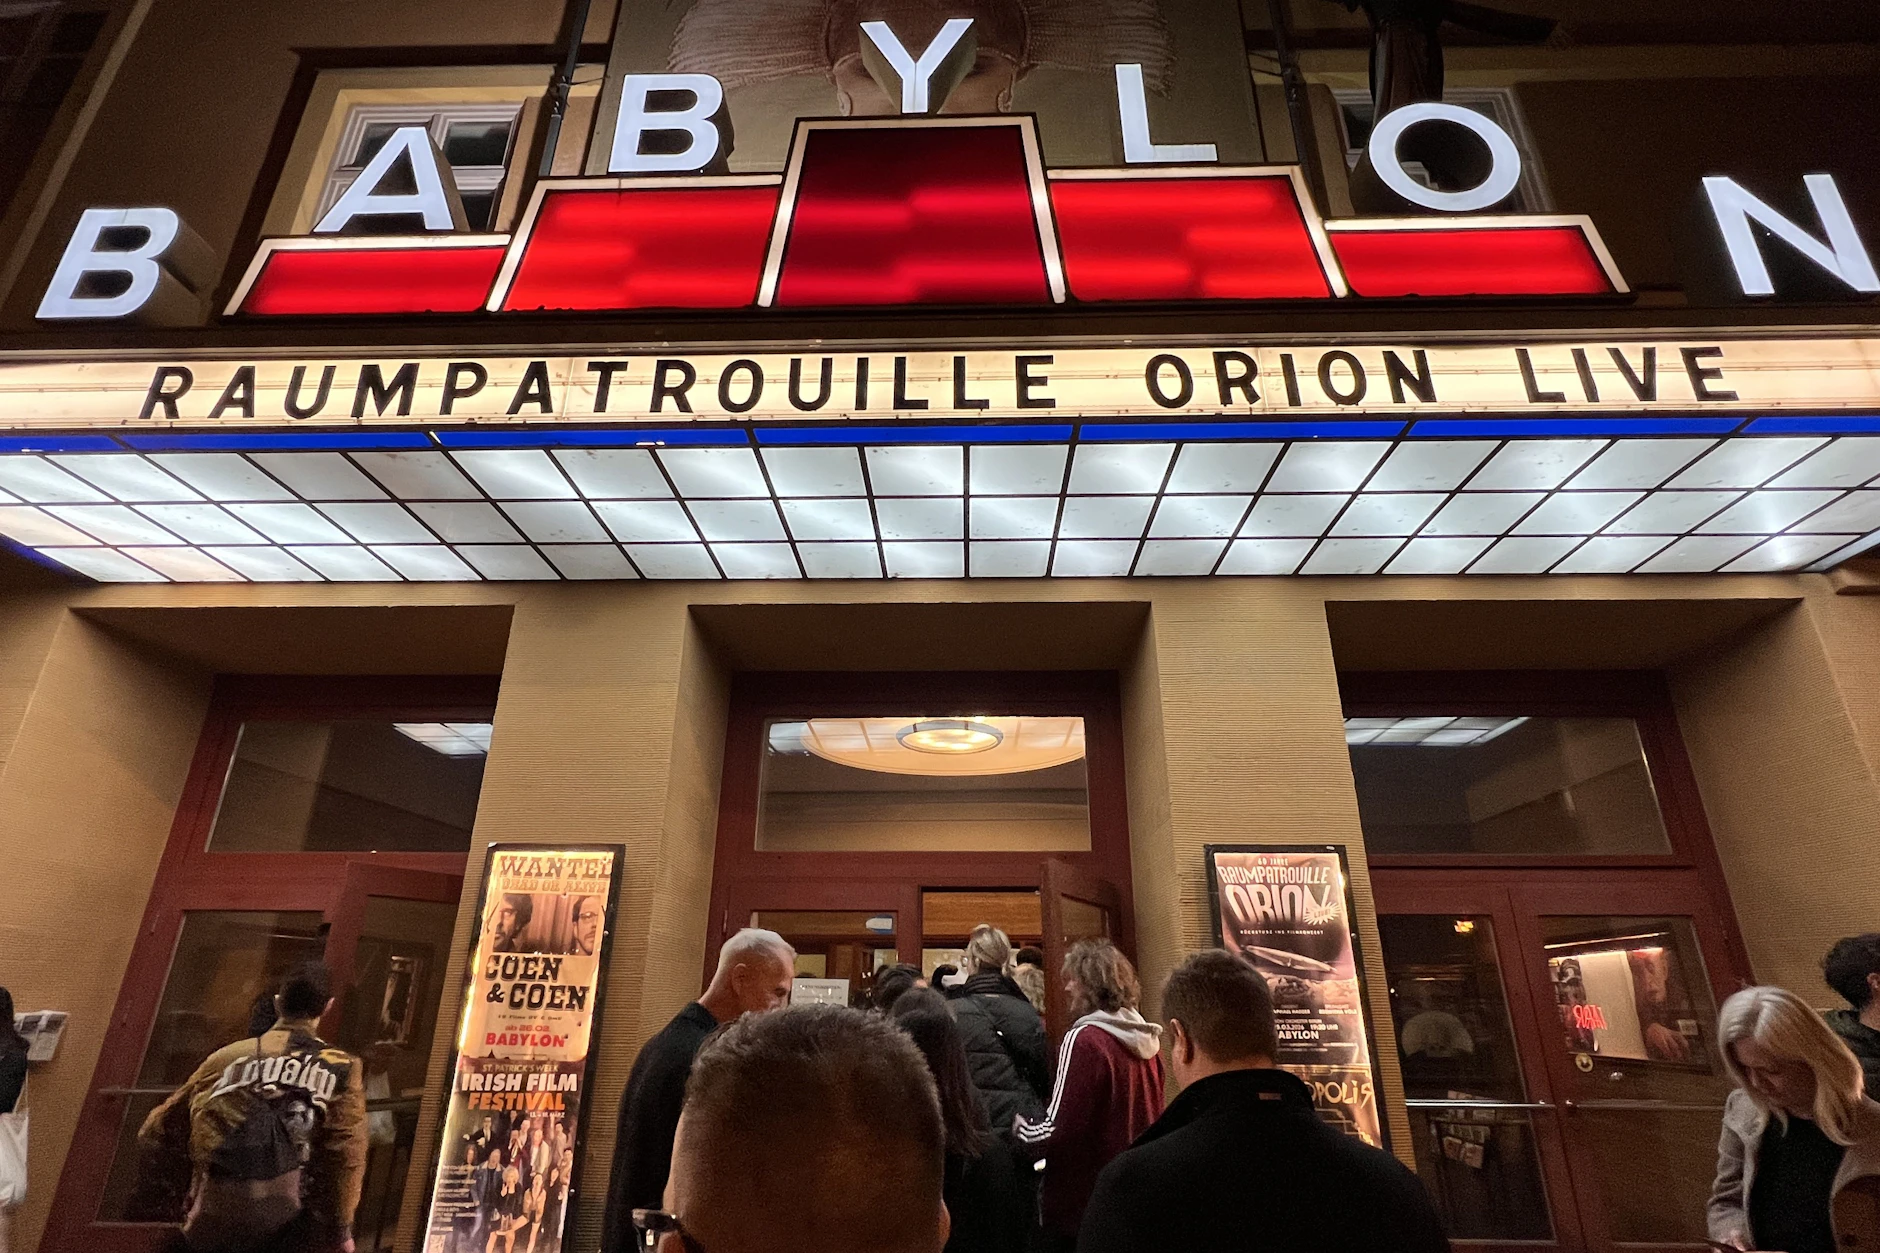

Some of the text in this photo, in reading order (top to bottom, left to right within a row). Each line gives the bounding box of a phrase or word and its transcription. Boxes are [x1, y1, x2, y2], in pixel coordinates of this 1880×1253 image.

[36, 18, 1880, 319] BABYLON
[140, 346, 1739, 420] RAUMPATROUILLE ORION LIVE
[1217, 866, 1330, 884] RAUMPATROUILLE
[502, 878, 606, 894] DEAD OR ALIVE
[1225, 884, 1331, 925] ORION
[485, 955, 563, 981] COEN
[486, 982, 590, 1011] & COEN
[486, 1032, 566, 1048] BABYLON
[1278, 1030, 1320, 1039] ABYLON
[536, 1063, 559, 1072] WEEK
[461, 1073, 578, 1092] IRISH FILM
[467, 1092, 566, 1111] FESTIVAL
